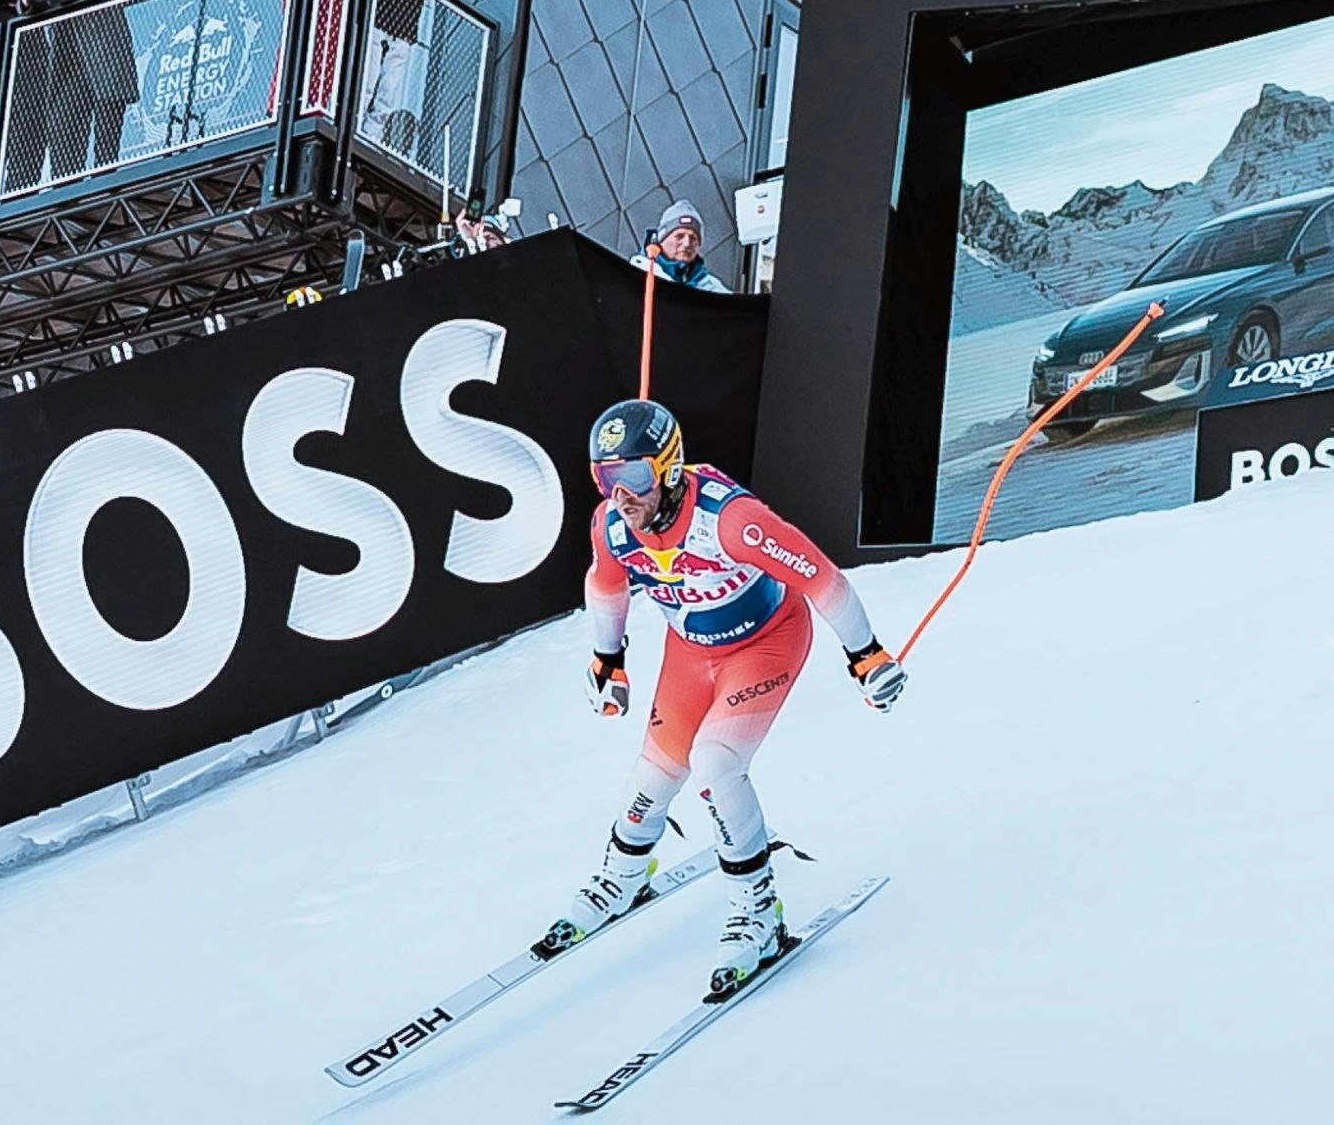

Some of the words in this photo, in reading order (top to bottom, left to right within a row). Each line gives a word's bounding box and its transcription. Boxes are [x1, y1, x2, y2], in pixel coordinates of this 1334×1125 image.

[159, 41, 194, 75] Red
[198, 35, 232, 63] Bull
[154, 77, 227, 113] STATION
[156, 58, 230, 96] ENERGY
[761, 536, 818, 579] Sunrise
[677, 570, 748, 604] Bull
[345, 1006, 454, 1078] HEAD
[578, 1051, 659, 1104] HEAD
